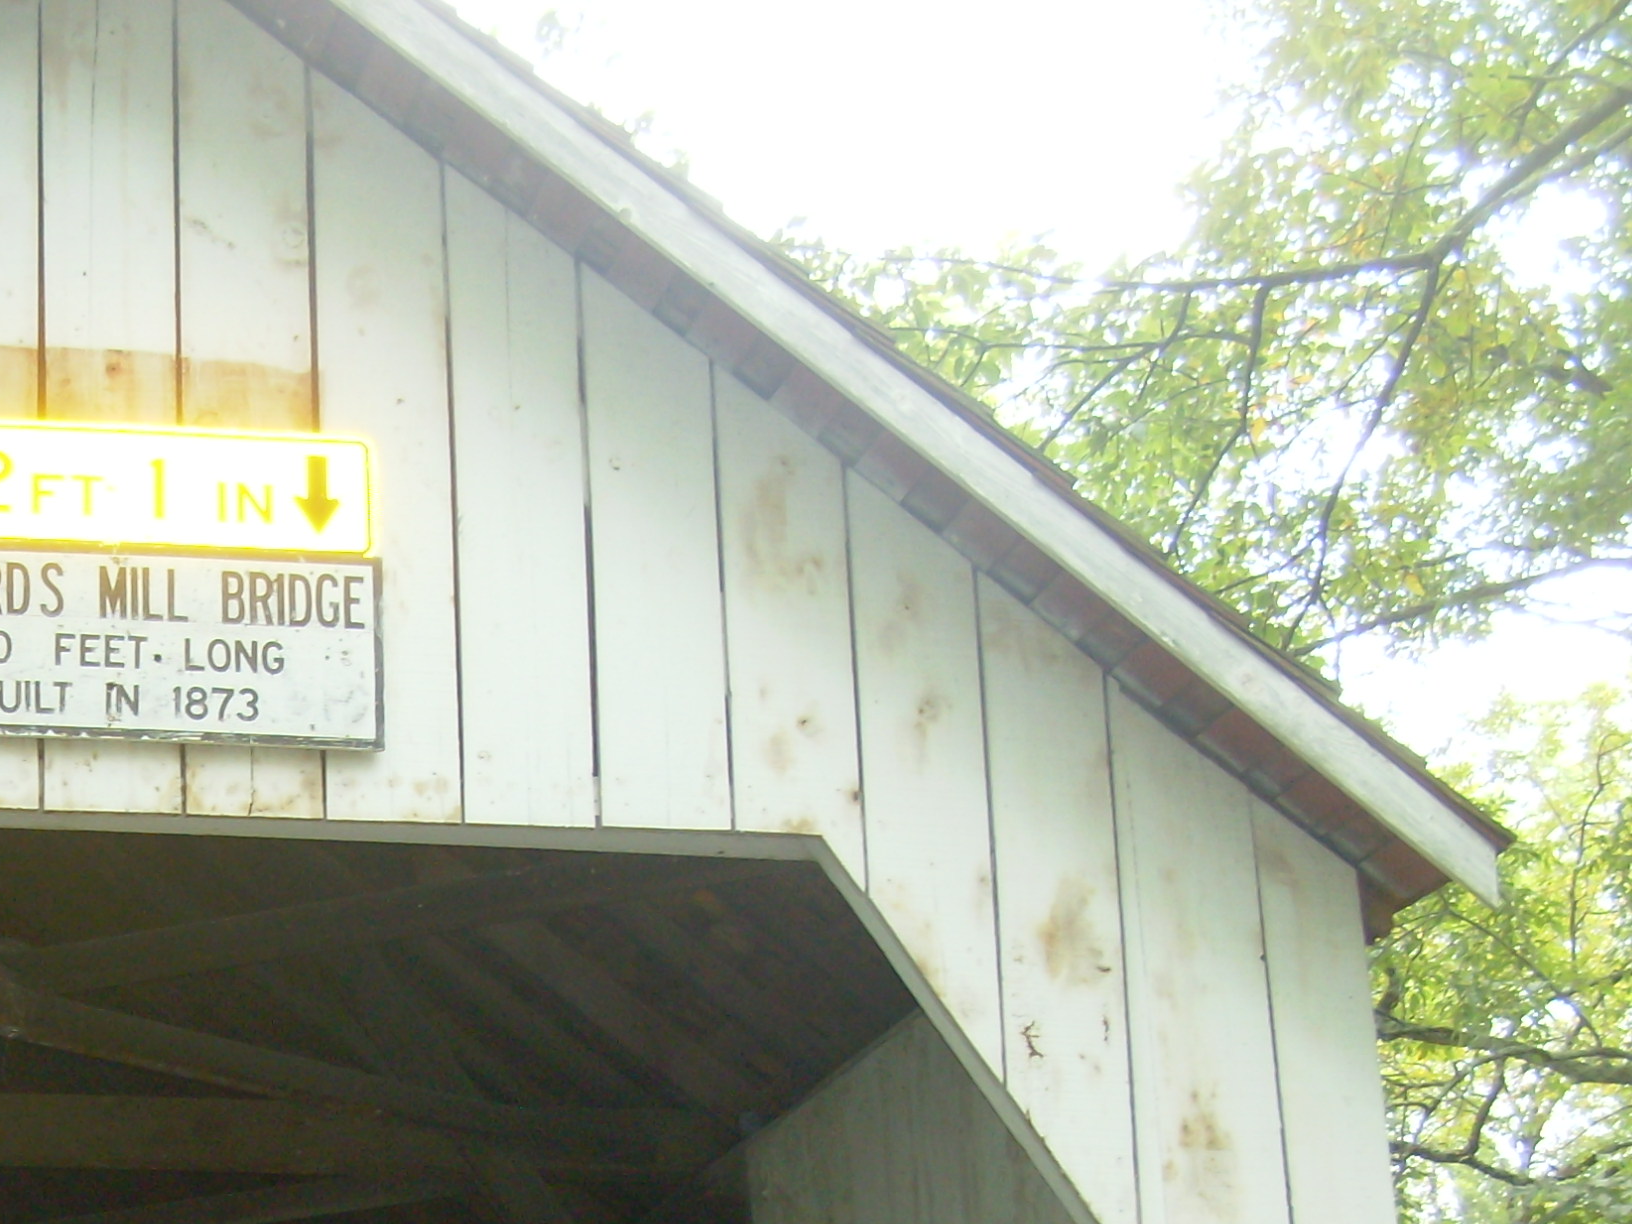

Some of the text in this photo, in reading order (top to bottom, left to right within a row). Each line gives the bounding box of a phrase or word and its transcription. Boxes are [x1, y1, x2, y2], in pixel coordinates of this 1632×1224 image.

[32, 474, 104, 516] FT
[149, 457, 165, 519] 1
[218, 482, 273, 523] IN
[99, 565, 189, 623] MILL
[221, 570, 366, 630] BRIDGE
[184, 638, 285, 675] LONG
[105, 682, 141, 718] IN
[173, 686, 260, 722] 1873
